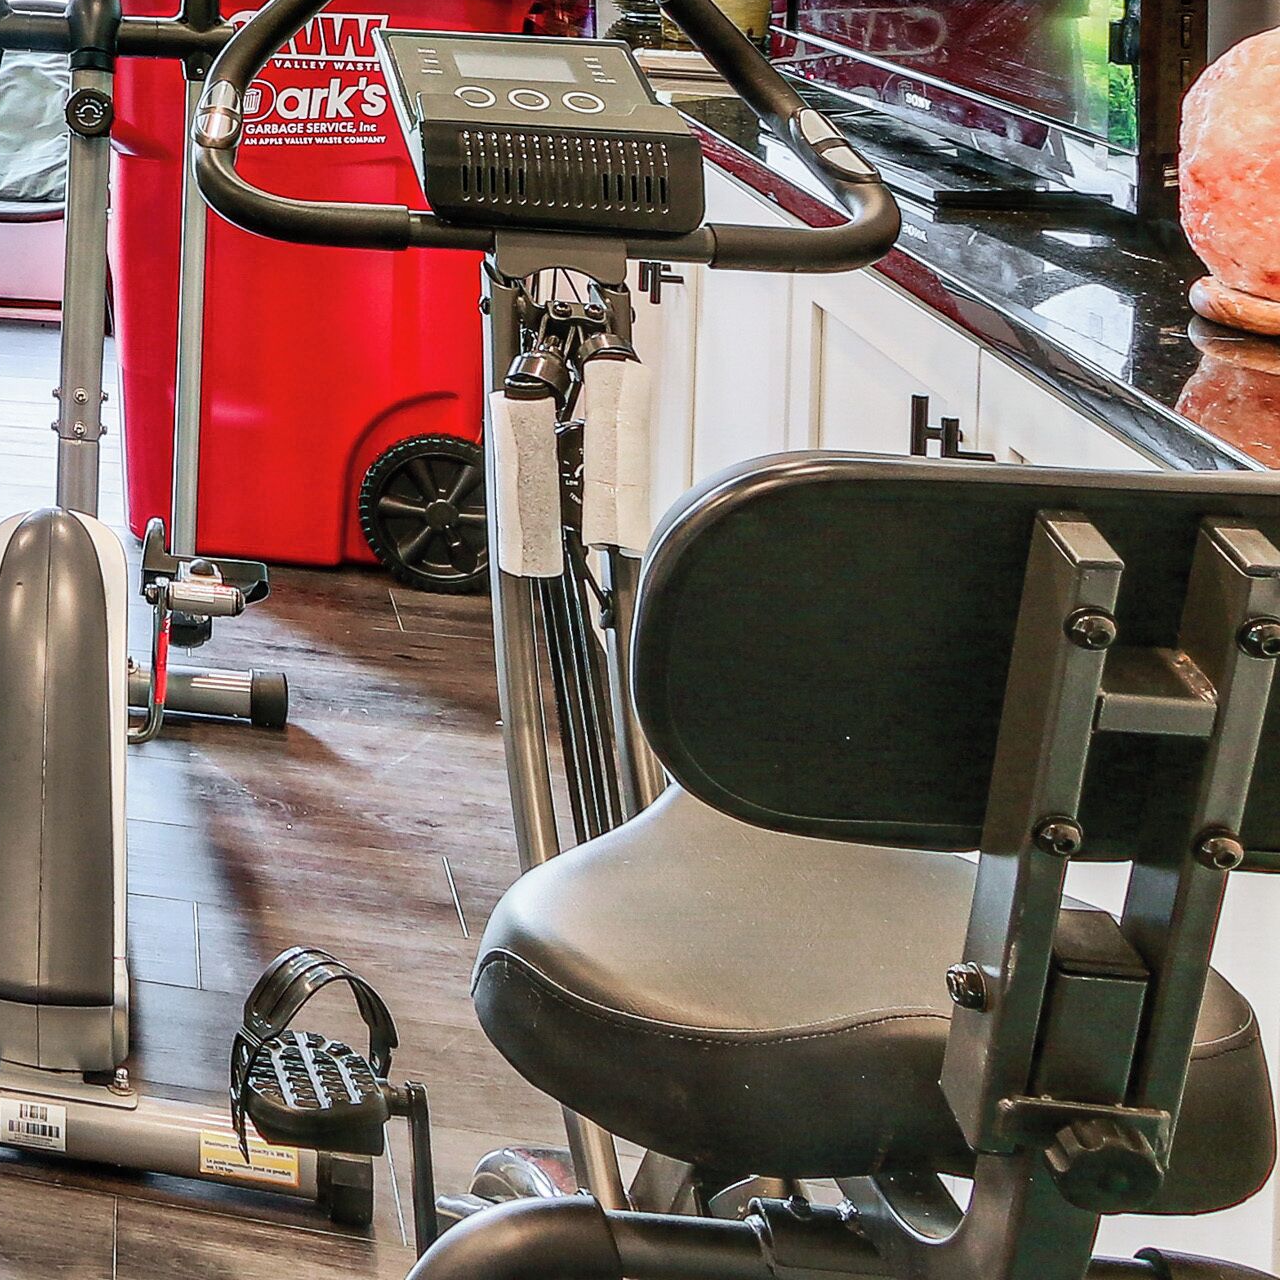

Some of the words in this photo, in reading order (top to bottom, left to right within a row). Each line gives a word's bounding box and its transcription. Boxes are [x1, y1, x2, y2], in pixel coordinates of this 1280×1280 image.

[274, 59, 327, 70] VALLEY
[333, 62, 381, 72] WASTE
[905, 92, 932, 111] SONY
[245, 122, 304, 134] GARBAGE
[306, 122, 356, 134] SERVICE,
[359, 122, 377, 132] Inc
[244, 137, 257, 145] AN
[258, 137, 283, 145] APPLE
[284, 137, 313, 145] VALLEY
[314, 136, 342, 144] WASTE
[343, 136, 386, 144] COMPANY
